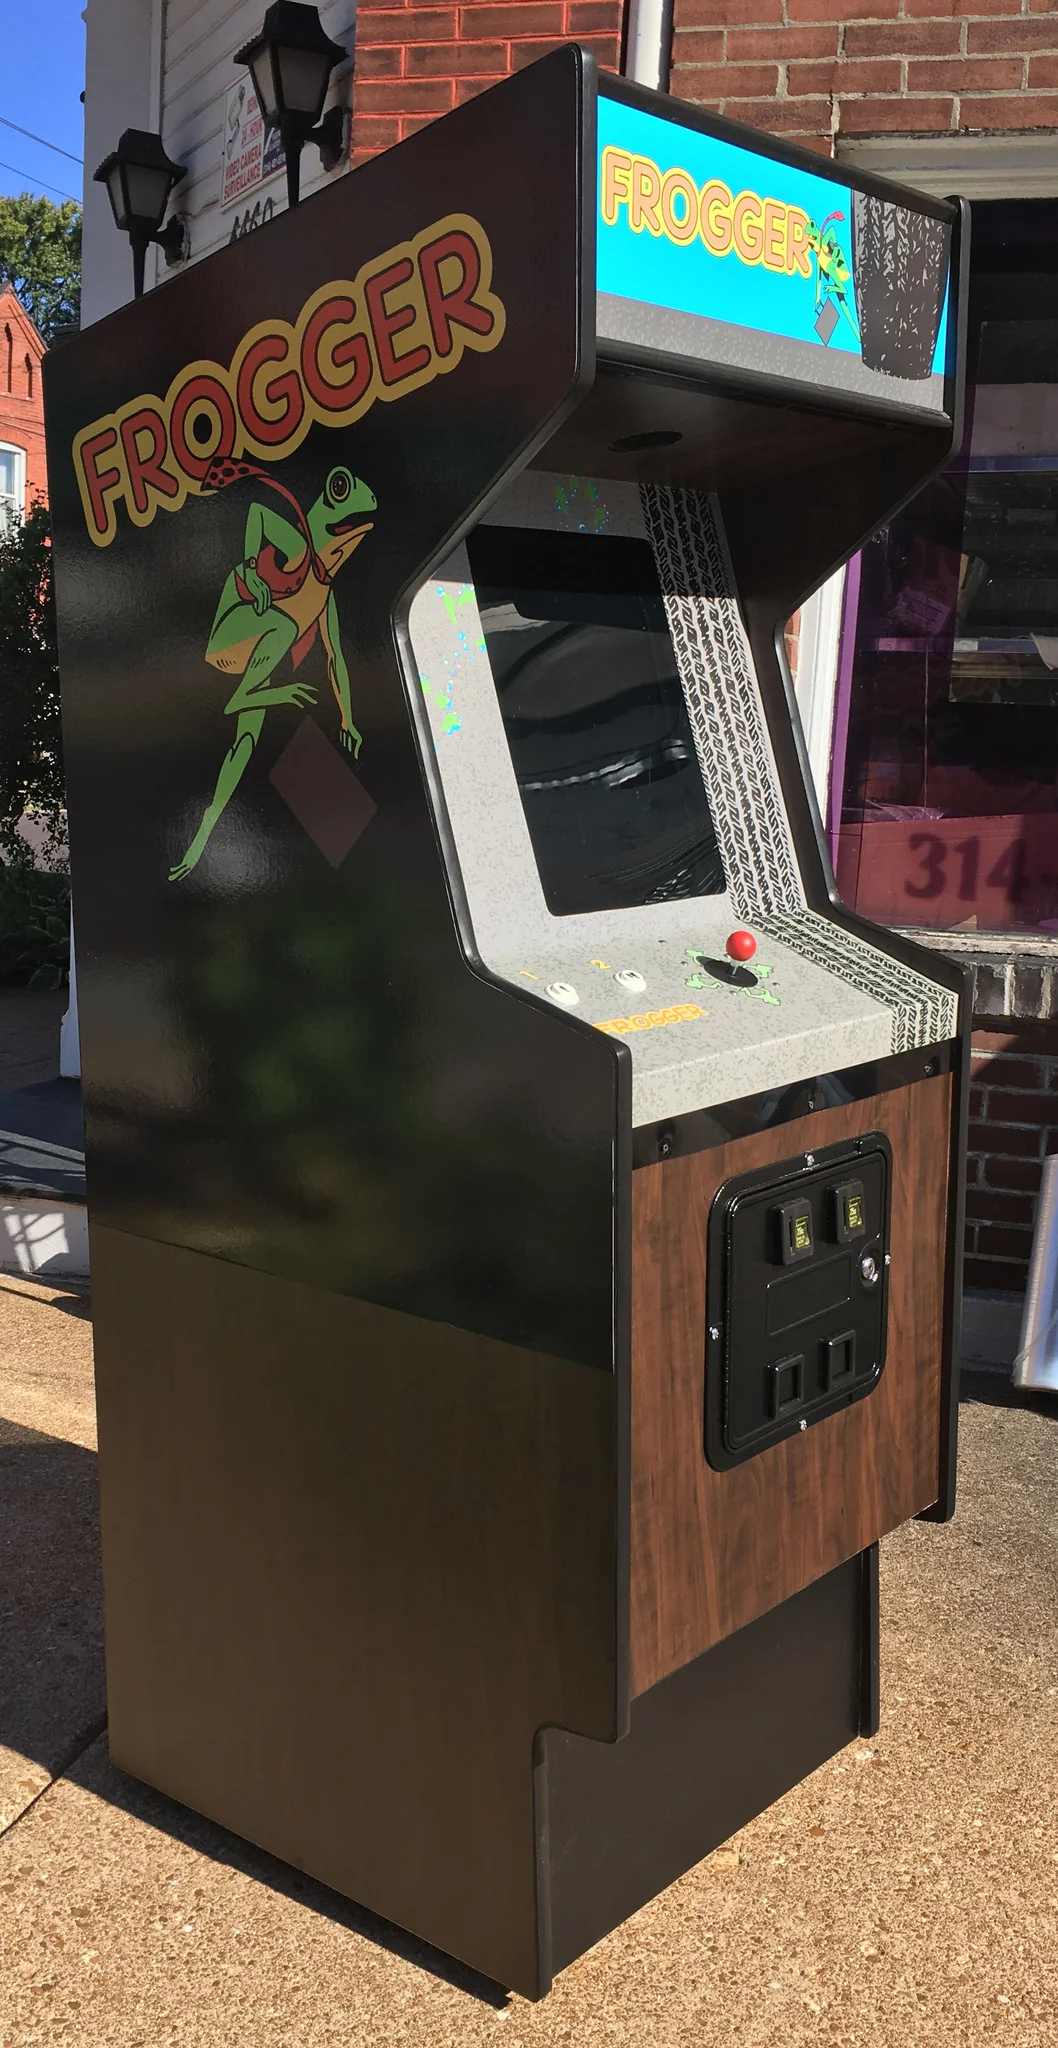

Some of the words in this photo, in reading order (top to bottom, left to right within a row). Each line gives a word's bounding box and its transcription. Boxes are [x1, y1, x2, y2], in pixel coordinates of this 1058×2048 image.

[226, 157, 240, 181] VIDEO
[241, 143, 261, 170] CAMERA
[224, 163, 261, 199] SURVEILLANCE
[603, 147, 811, 276] FROGGER
[76, 223, 499, 540] FROGGER
[518, 970, 538, 980] 1
[590, 959, 612, 970] 2
